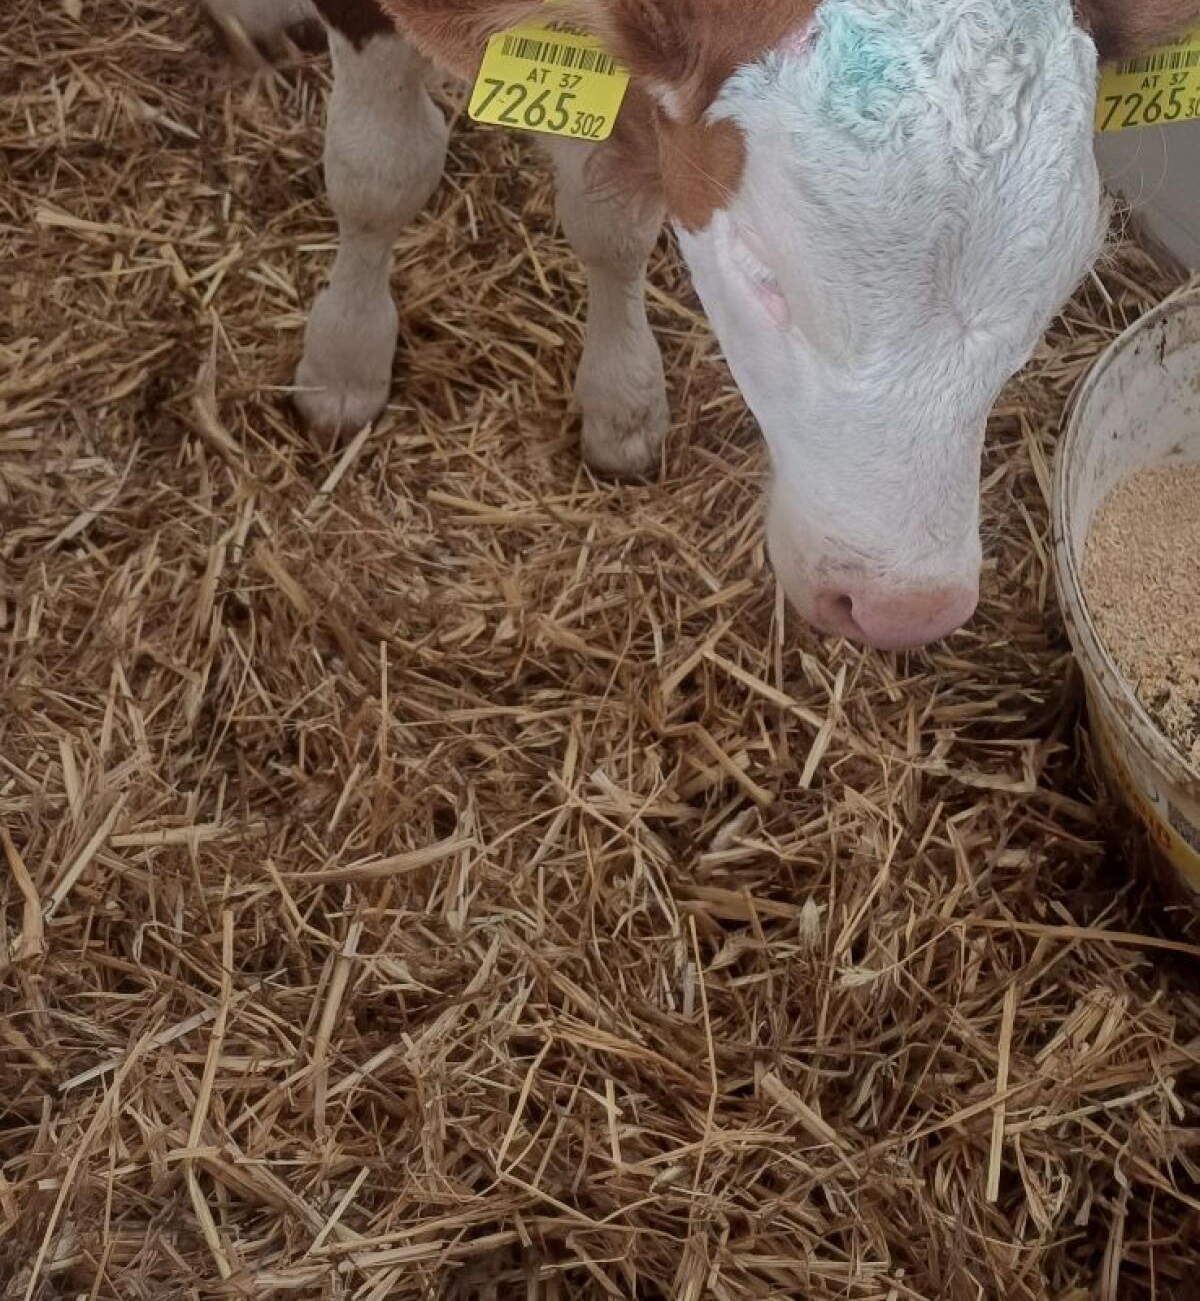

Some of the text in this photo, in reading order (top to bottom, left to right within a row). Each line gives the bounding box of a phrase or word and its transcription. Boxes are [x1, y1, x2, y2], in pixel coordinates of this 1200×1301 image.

[526, 68, 583, 89] AT 37
[1141, 71, 1190, 90] AT 37
[474, 78, 606, 138] 7265 302
[1100, 87, 1186, 132] 7265
